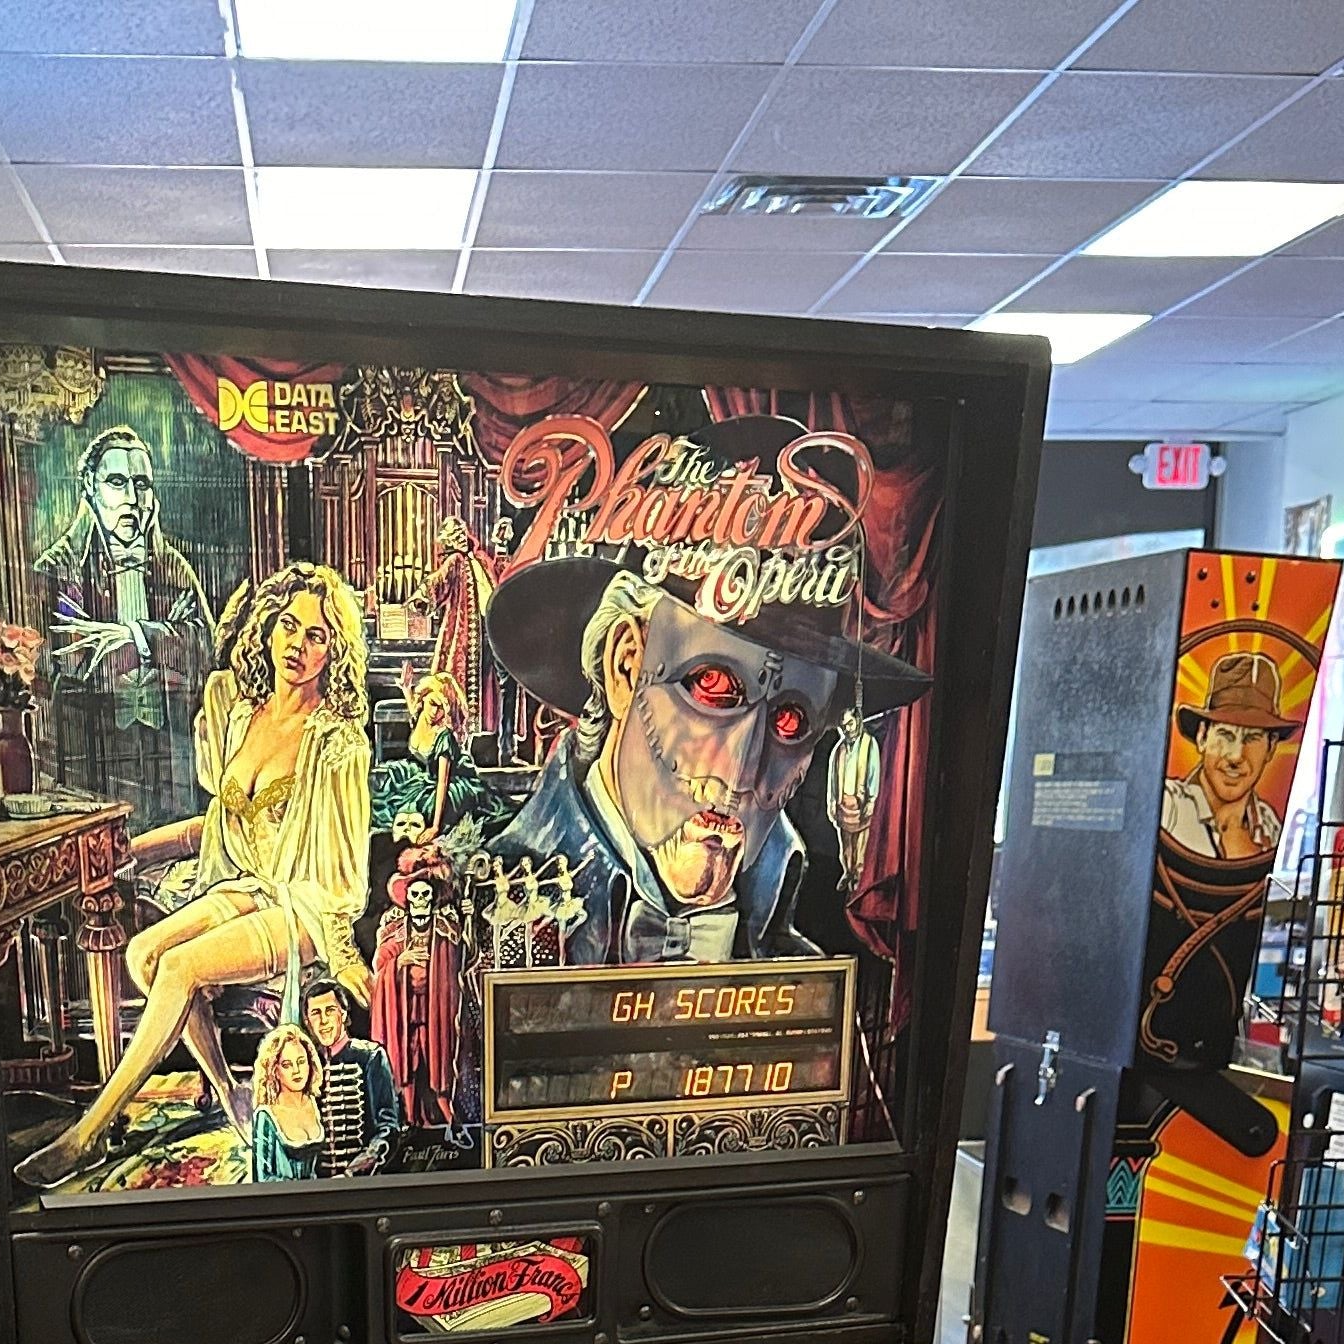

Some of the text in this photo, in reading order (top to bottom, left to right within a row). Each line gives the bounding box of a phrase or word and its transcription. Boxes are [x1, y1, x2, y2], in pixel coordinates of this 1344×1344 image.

[274, 382, 336, 408] DATA
[275, 409, 340, 435] EAST
[658, 437, 717, 485] The
[1158, 446, 1201, 485] EXIT
[497, 414, 875, 582] Phantom
[696, 544, 859, 625] Opera
[612, 984, 796, 1023] GH SCORES
[610, 1070, 633, 1099] P
[404, 1280, 429, 1307] 1
[423, 1269, 509, 1311] Million
